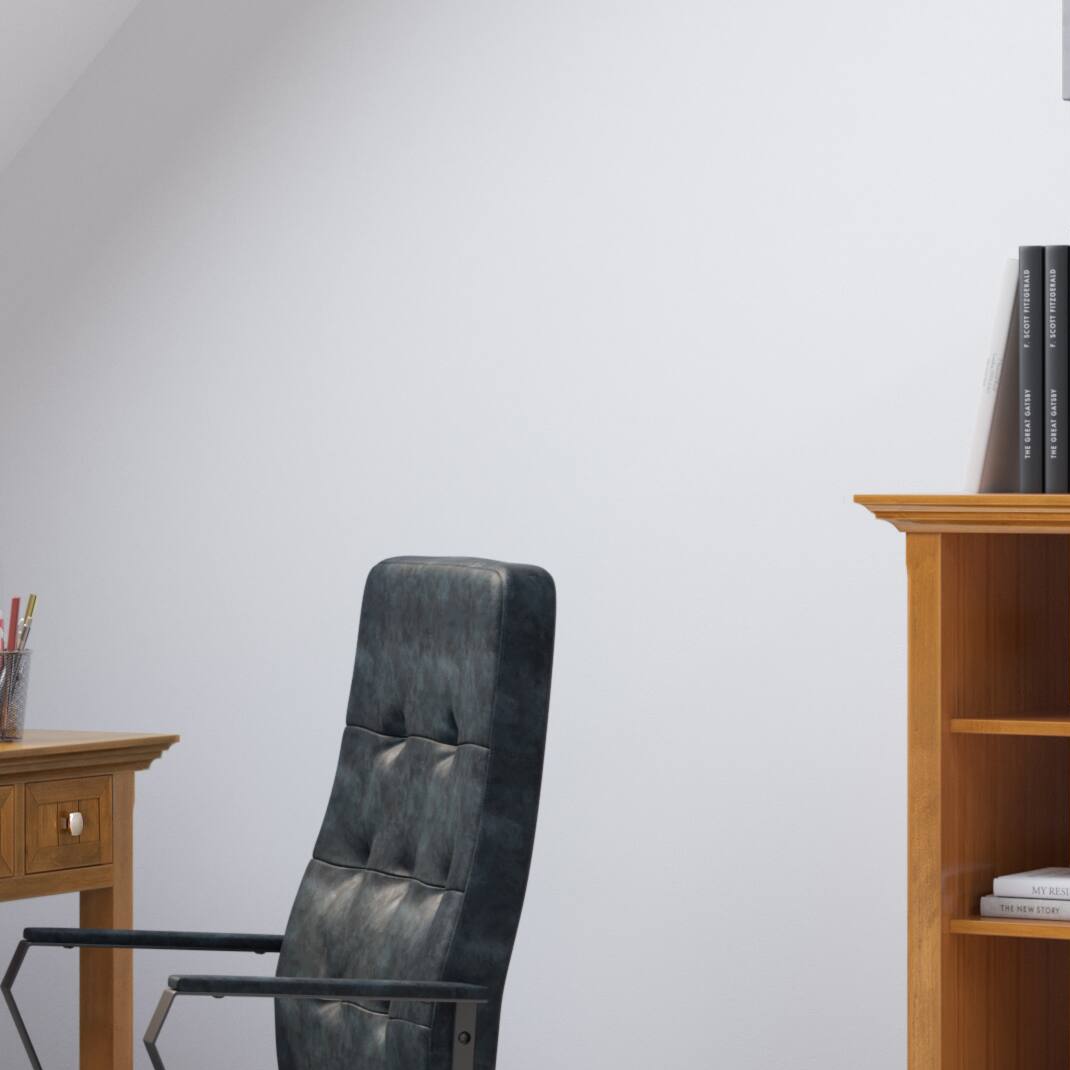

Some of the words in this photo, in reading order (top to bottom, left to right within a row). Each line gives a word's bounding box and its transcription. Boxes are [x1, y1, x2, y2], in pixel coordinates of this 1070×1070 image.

[1032, 886, 1048, 896] MY
[1000, 904, 1015, 912] THE
[1016, 904, 1034, 913] NEW
[1036, 906, 1060, 914] STORY
